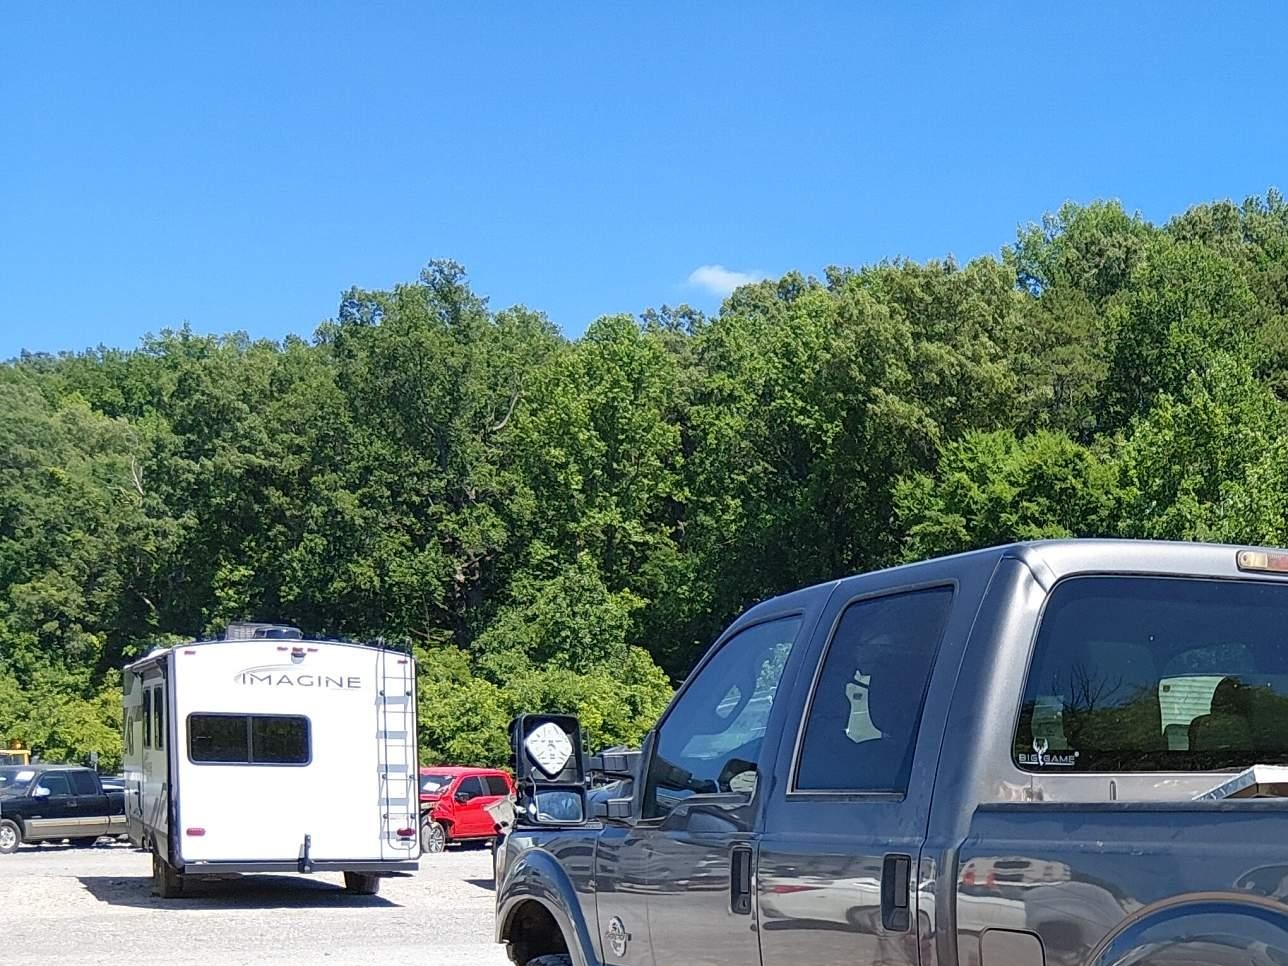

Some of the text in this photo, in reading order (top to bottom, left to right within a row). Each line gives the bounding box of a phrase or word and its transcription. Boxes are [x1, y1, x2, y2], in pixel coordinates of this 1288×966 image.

[242, 672, 362, 689] IMAGINE
[1019, 754, 1075, 763] BIG GAME
